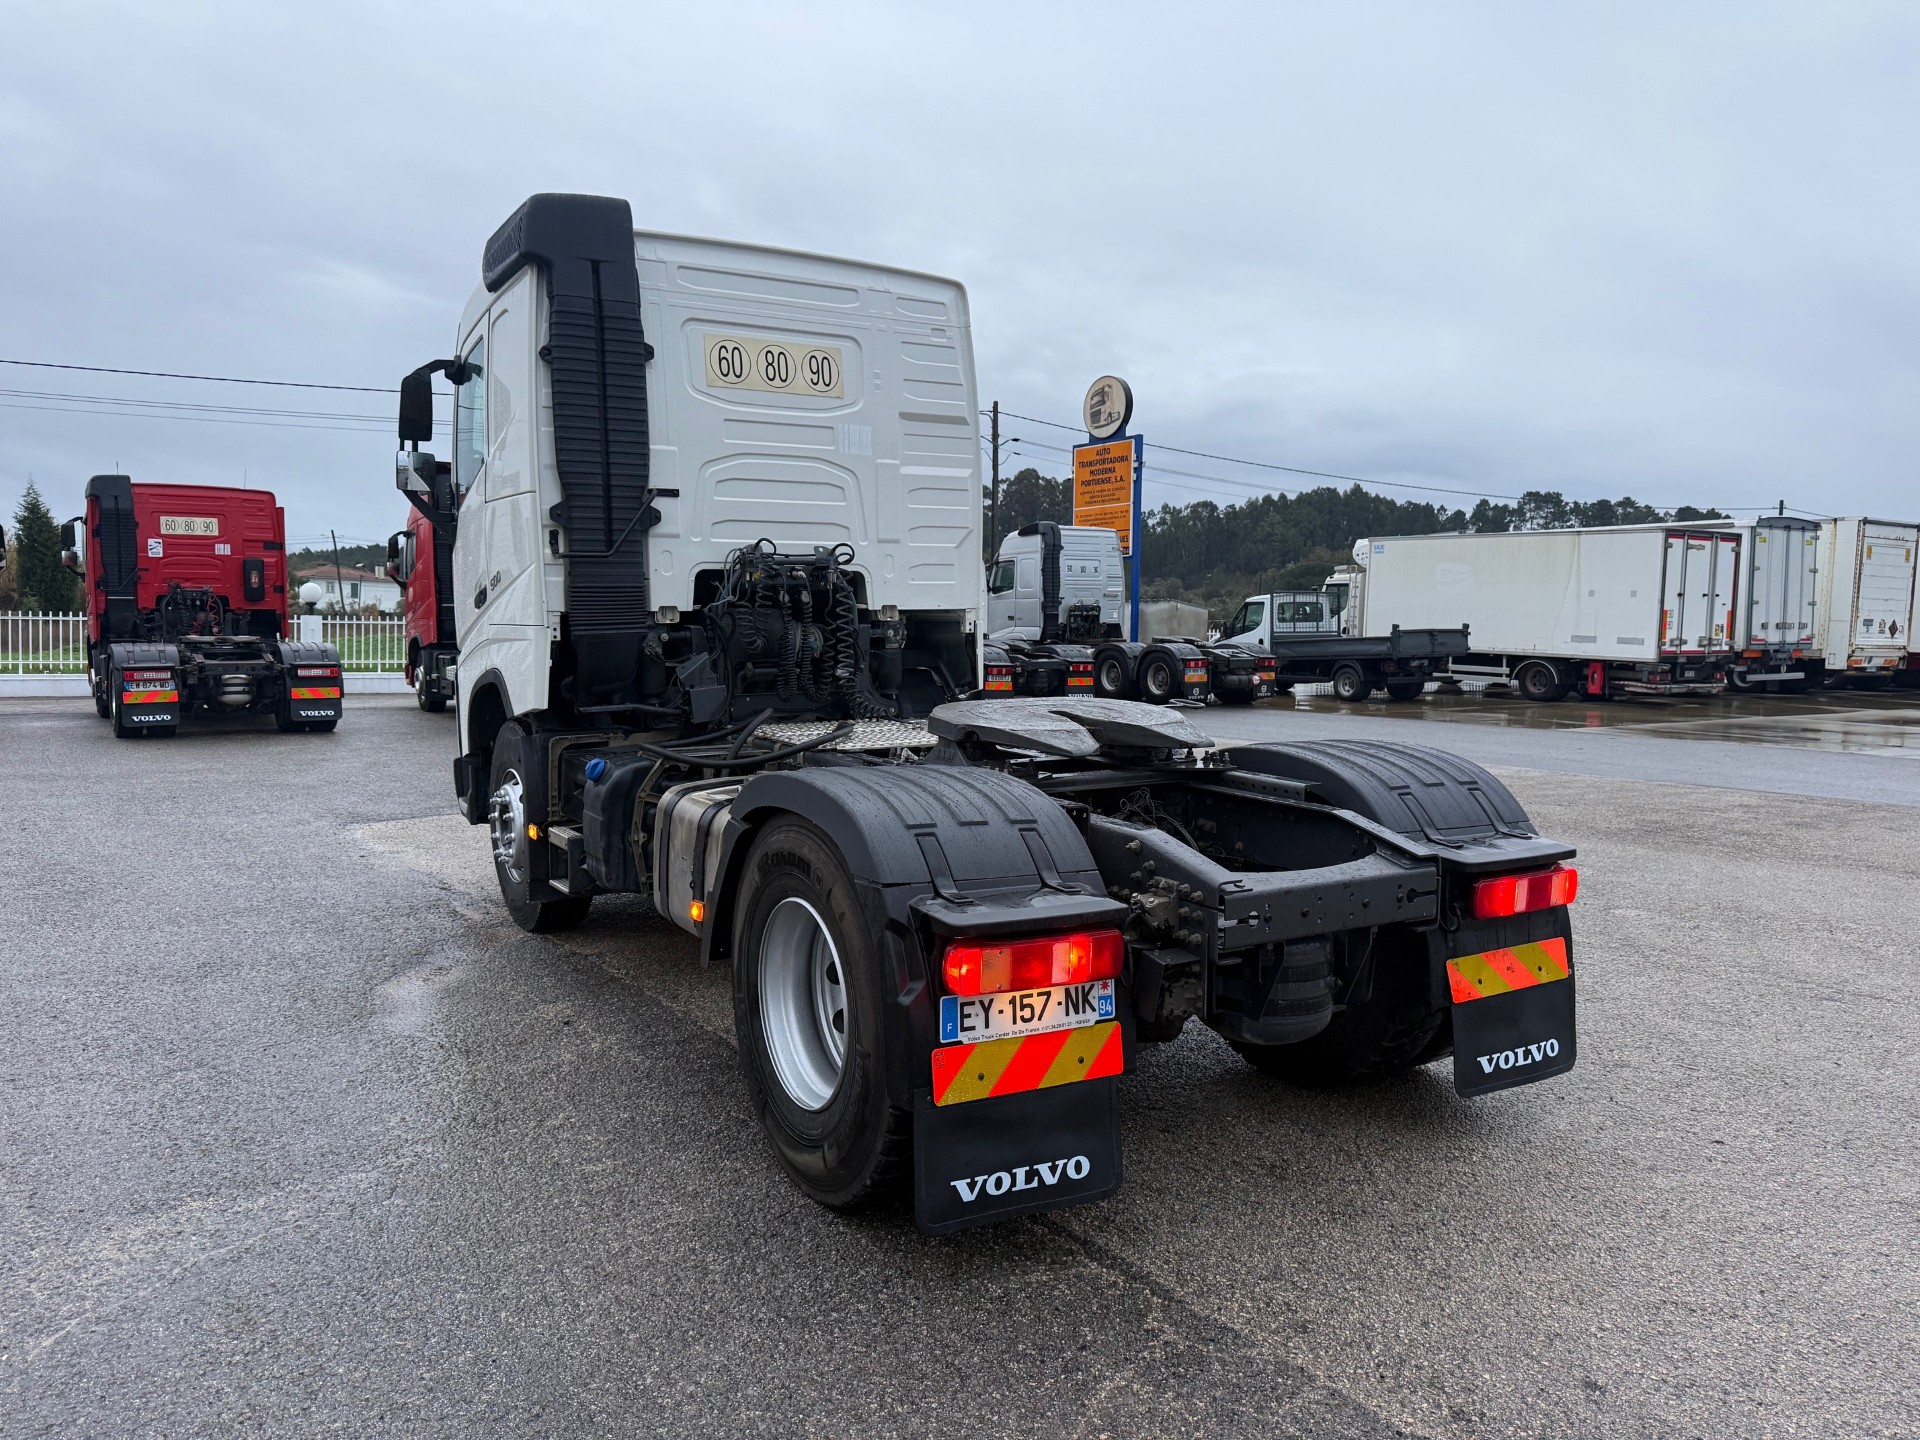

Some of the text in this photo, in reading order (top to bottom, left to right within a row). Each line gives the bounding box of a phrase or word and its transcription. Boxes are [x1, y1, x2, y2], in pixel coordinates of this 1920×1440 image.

[718, 344, 832, 388] 60 80 90
[1095, 447, 1111, 457] AUTO
[1078, 454, 1129, 469] TRANSPORTADORA
[1089, 466, 1117, 477] MODERNA
[1080, 475, 1126, 488] PORTUENSE, S.A.
[164, 519, 214, 533] 60 80 90
[131, 714, 172, 722] VOLVO
[1099, 999, 1113, 1015] 94
[946, 1022, 953, 1033] F
[1477, 1038, 1559, 1074] VOLVO
[950, 1155, 1091, 1203] VOLVO
